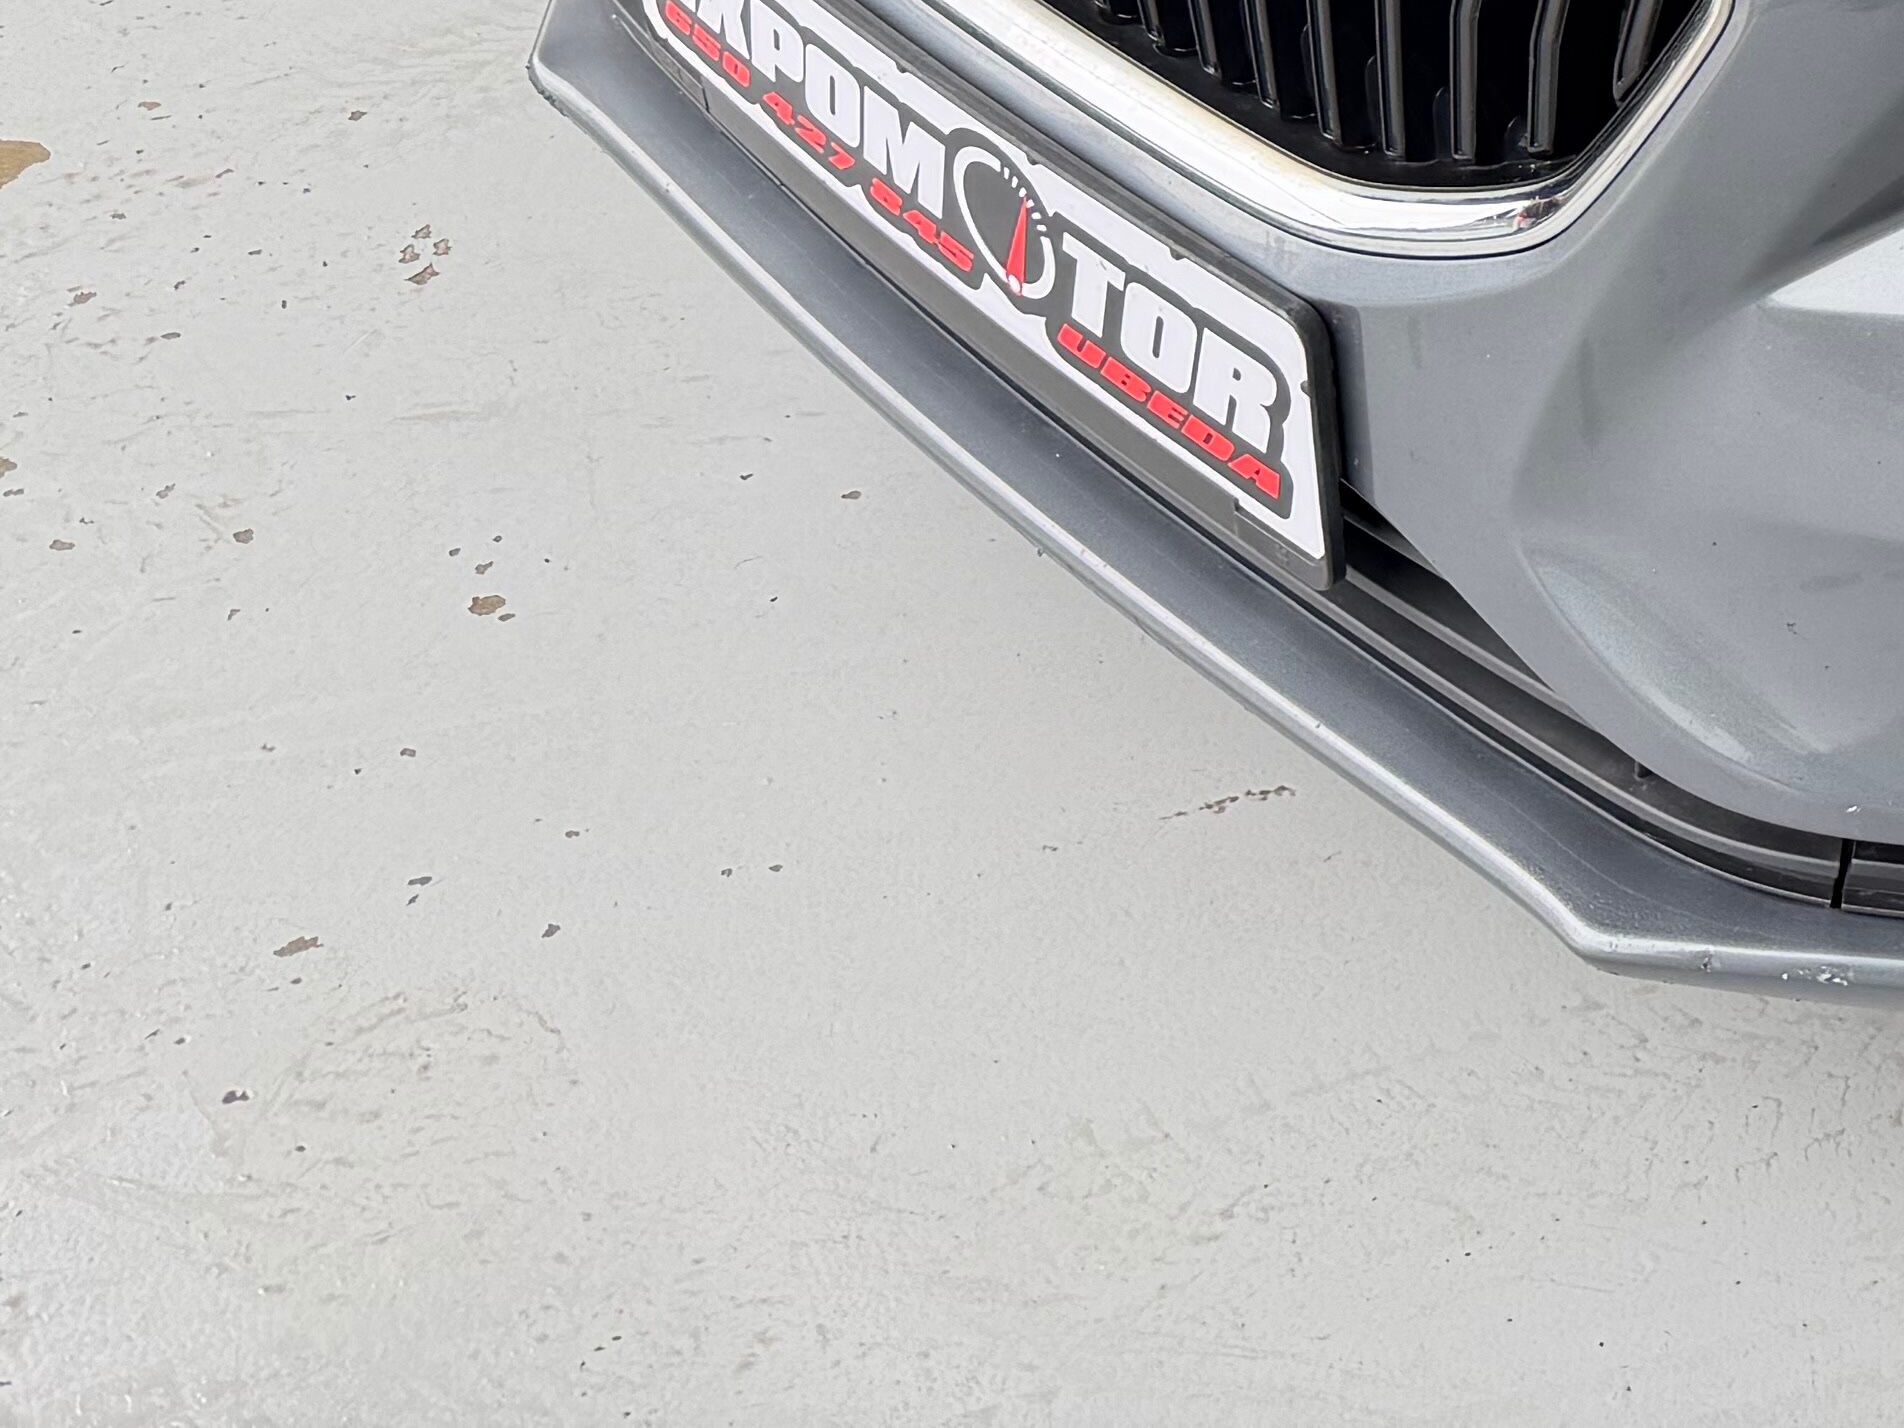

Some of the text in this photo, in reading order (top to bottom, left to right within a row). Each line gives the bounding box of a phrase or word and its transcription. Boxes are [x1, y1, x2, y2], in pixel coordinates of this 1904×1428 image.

[665, 0, 750, 88] 650
[762, 91, 855, 170] 427
[1056, 322, 1281, 501] UBEDA
